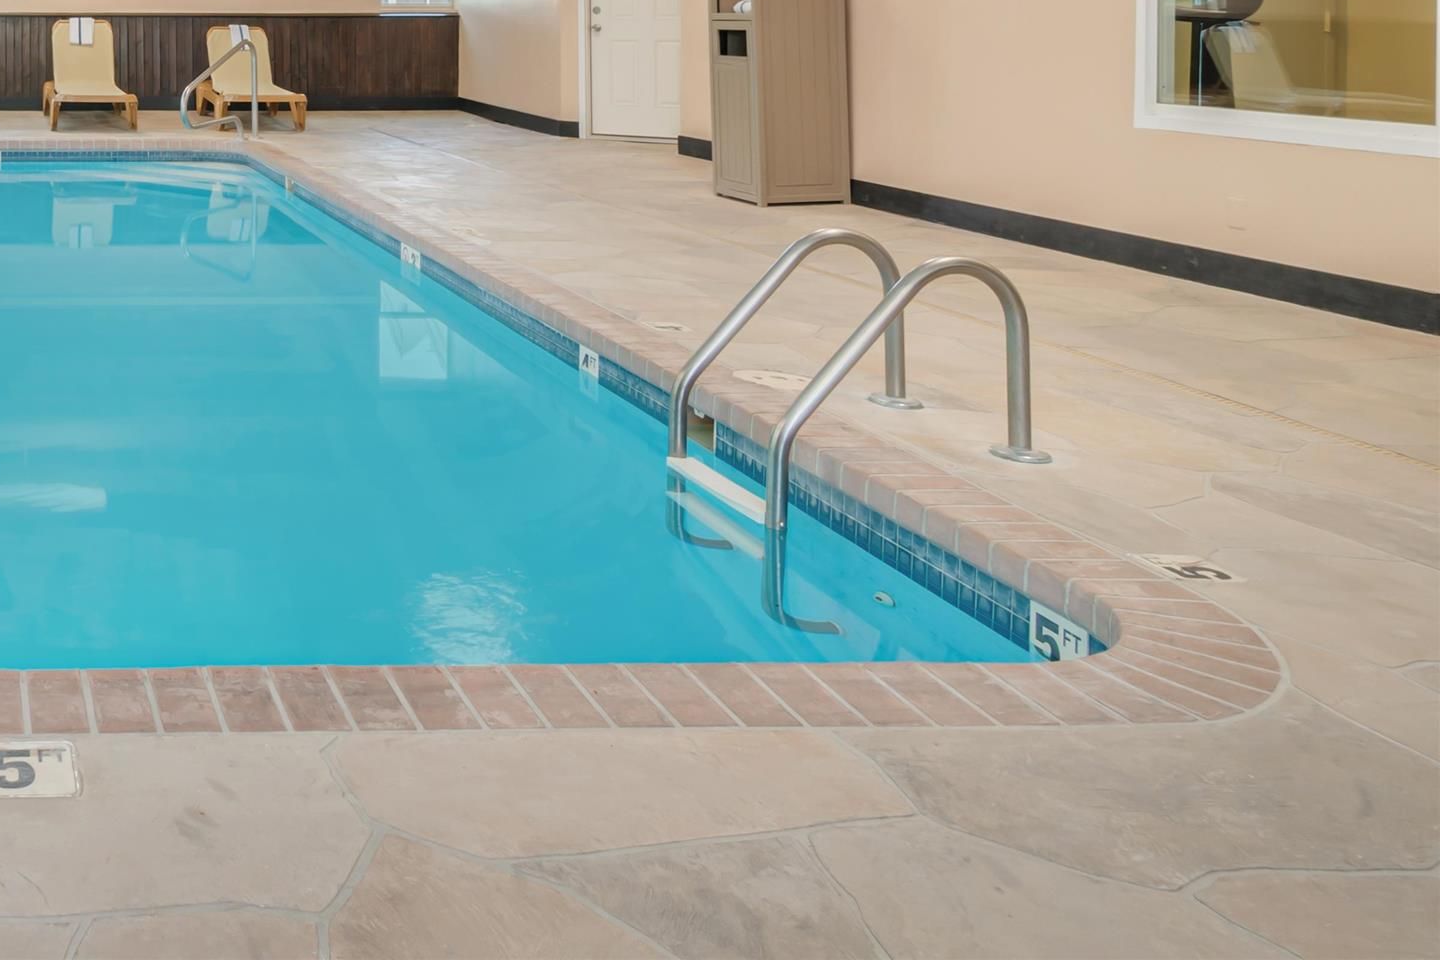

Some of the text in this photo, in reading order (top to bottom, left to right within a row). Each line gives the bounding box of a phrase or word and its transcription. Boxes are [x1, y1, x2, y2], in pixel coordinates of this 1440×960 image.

[1033, 611, 1083, 662] 5 FT
[37, 748, 67, 763] FT
